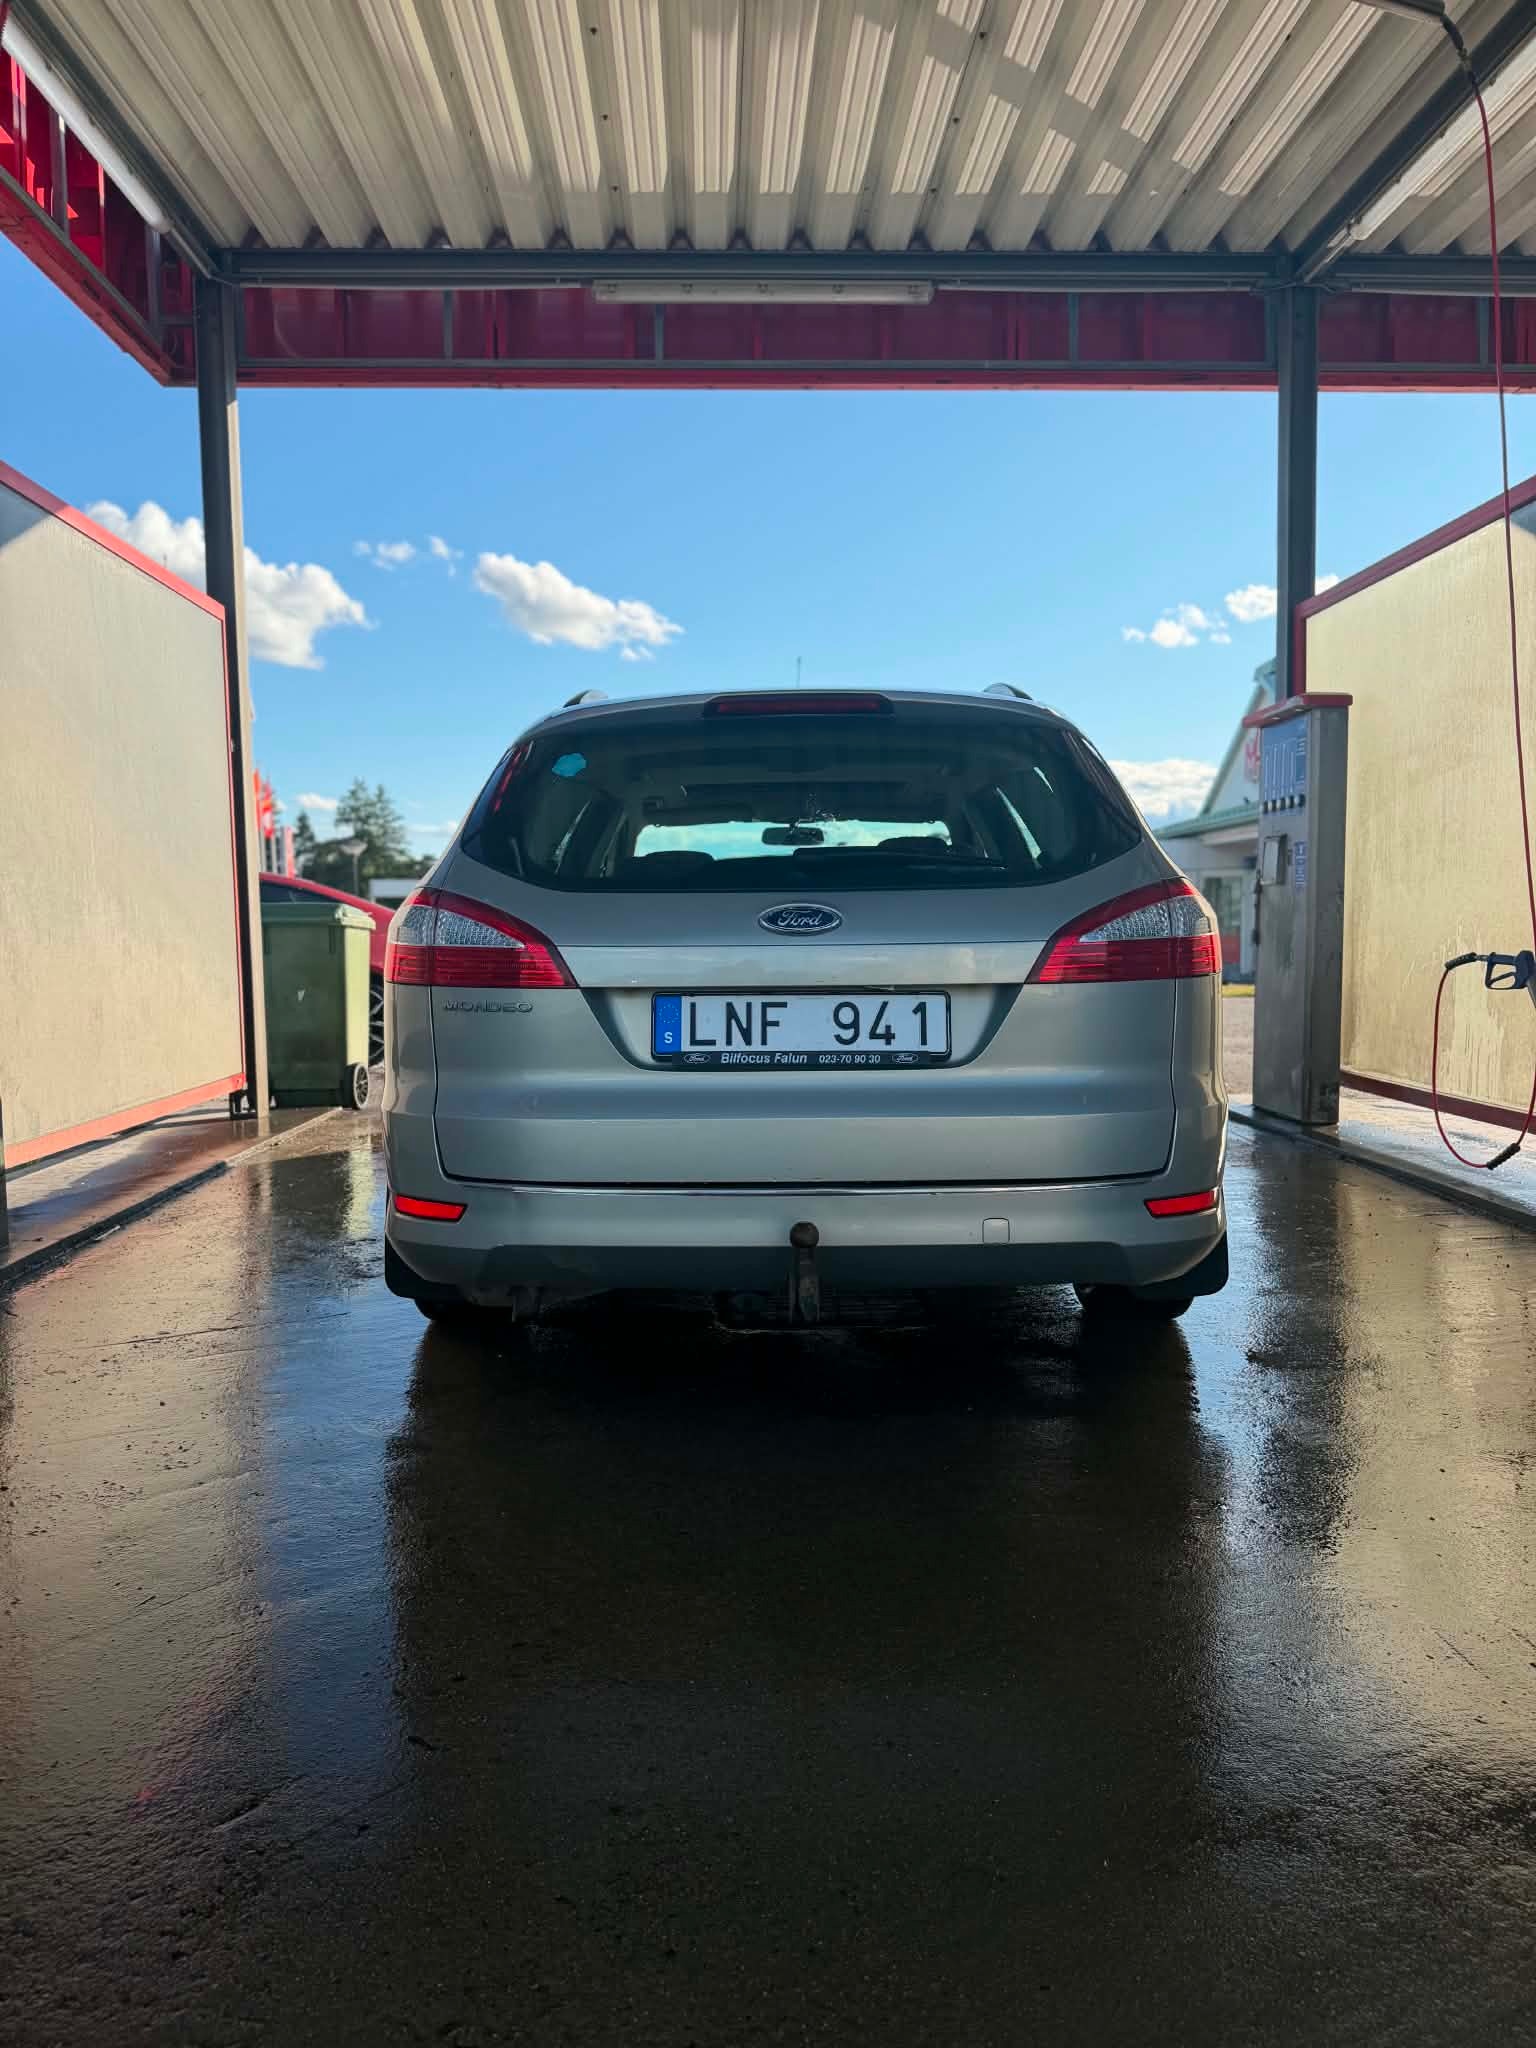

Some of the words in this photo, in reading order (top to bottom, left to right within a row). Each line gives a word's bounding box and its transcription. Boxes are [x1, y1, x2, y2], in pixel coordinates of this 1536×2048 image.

[777, 910, 824, 926] Ford
[689, 1001, 788, 1046] LNF
[833, 1001, 928, 1046] 941
[664, 1031, 673, 1044] S
[721, 1052, 771, 1064] Bilfocus
[774, 1052, 808, 1064] Falun
